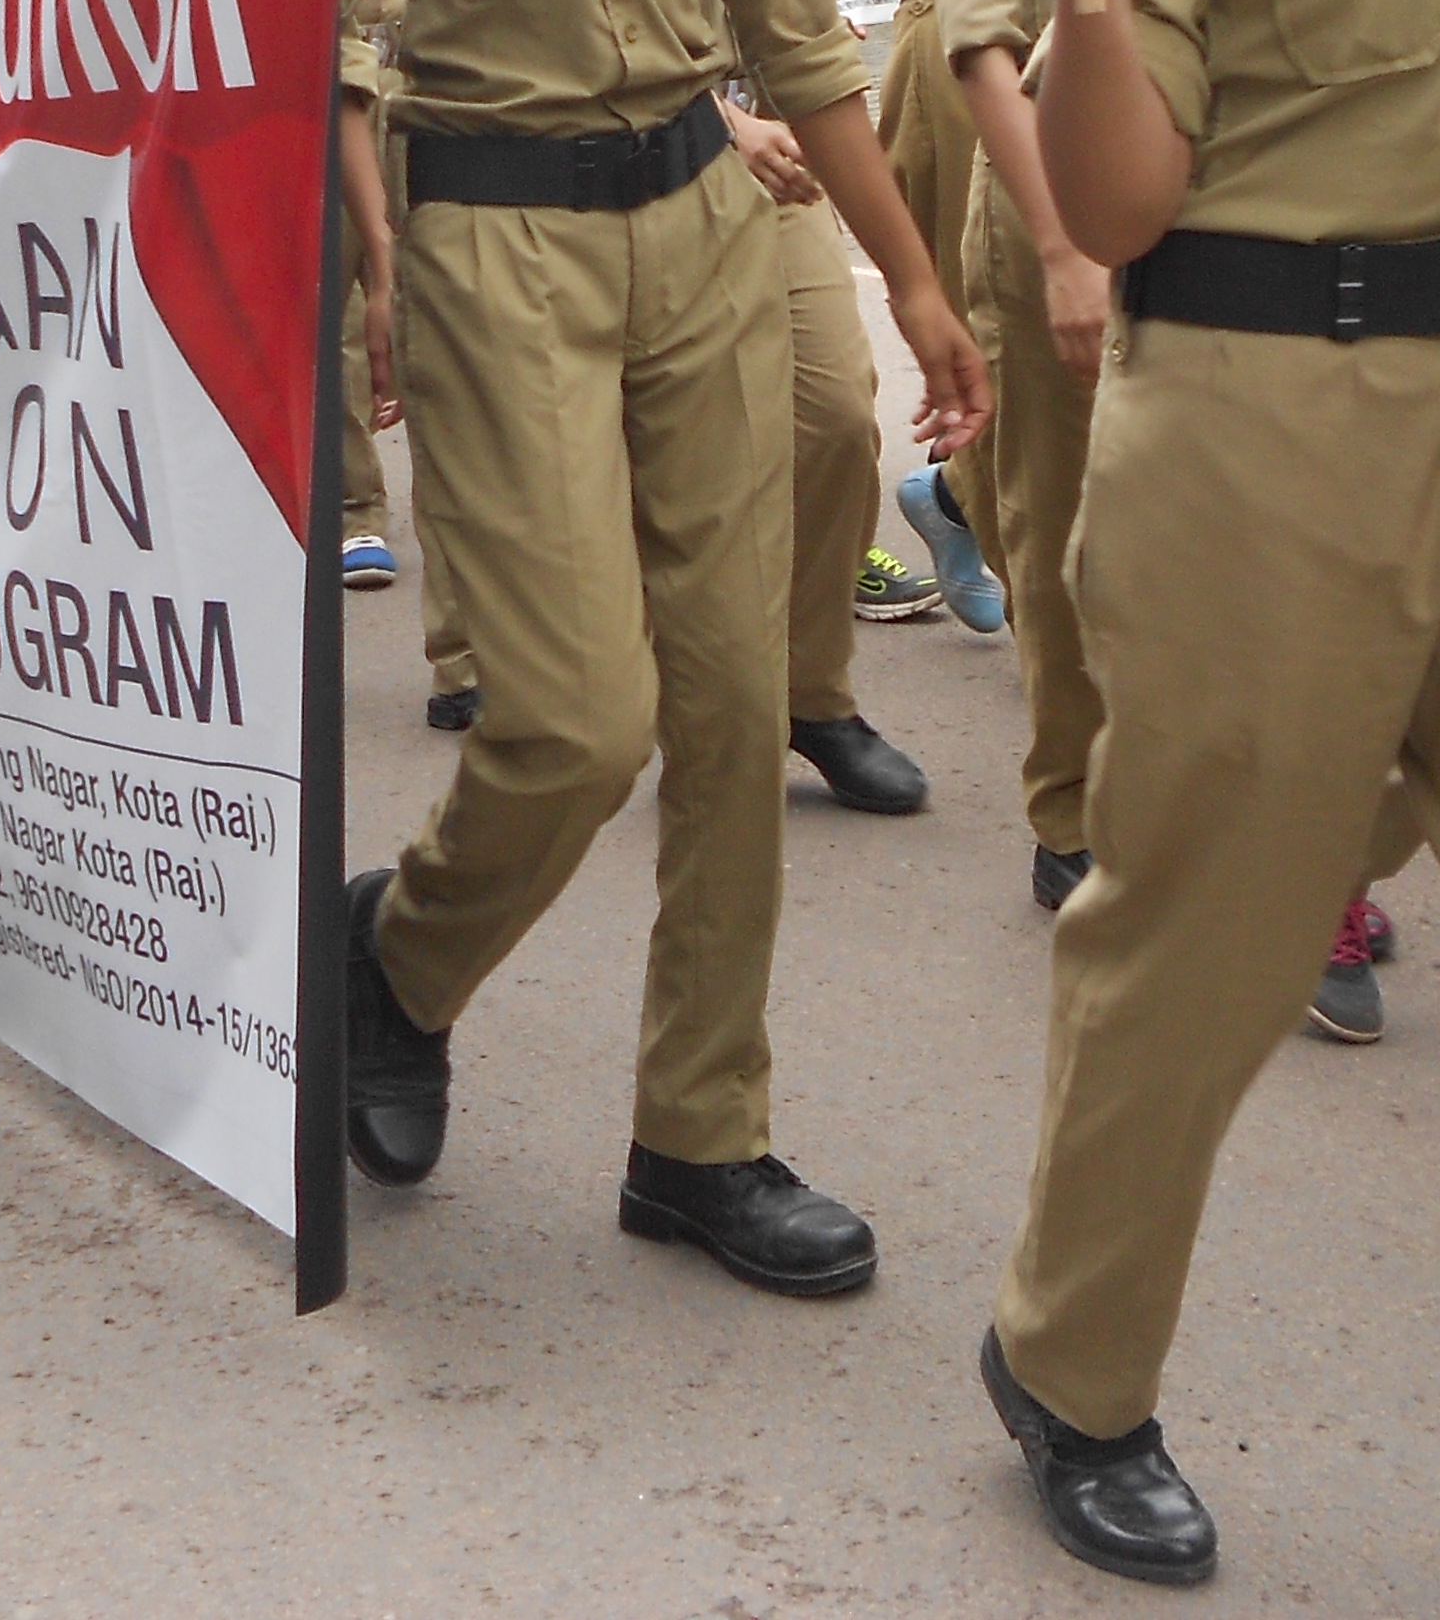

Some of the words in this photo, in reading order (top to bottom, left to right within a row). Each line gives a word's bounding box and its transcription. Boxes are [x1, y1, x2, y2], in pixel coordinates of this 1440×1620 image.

[26, 745, 109, 819] Nagar,
[112, 770, 184, 829] Kota
[191, 786, 277, 857] (Raj.)
[72, 827, 137, 889] Kota
[145, 846, 227, 918] (Raj.)
